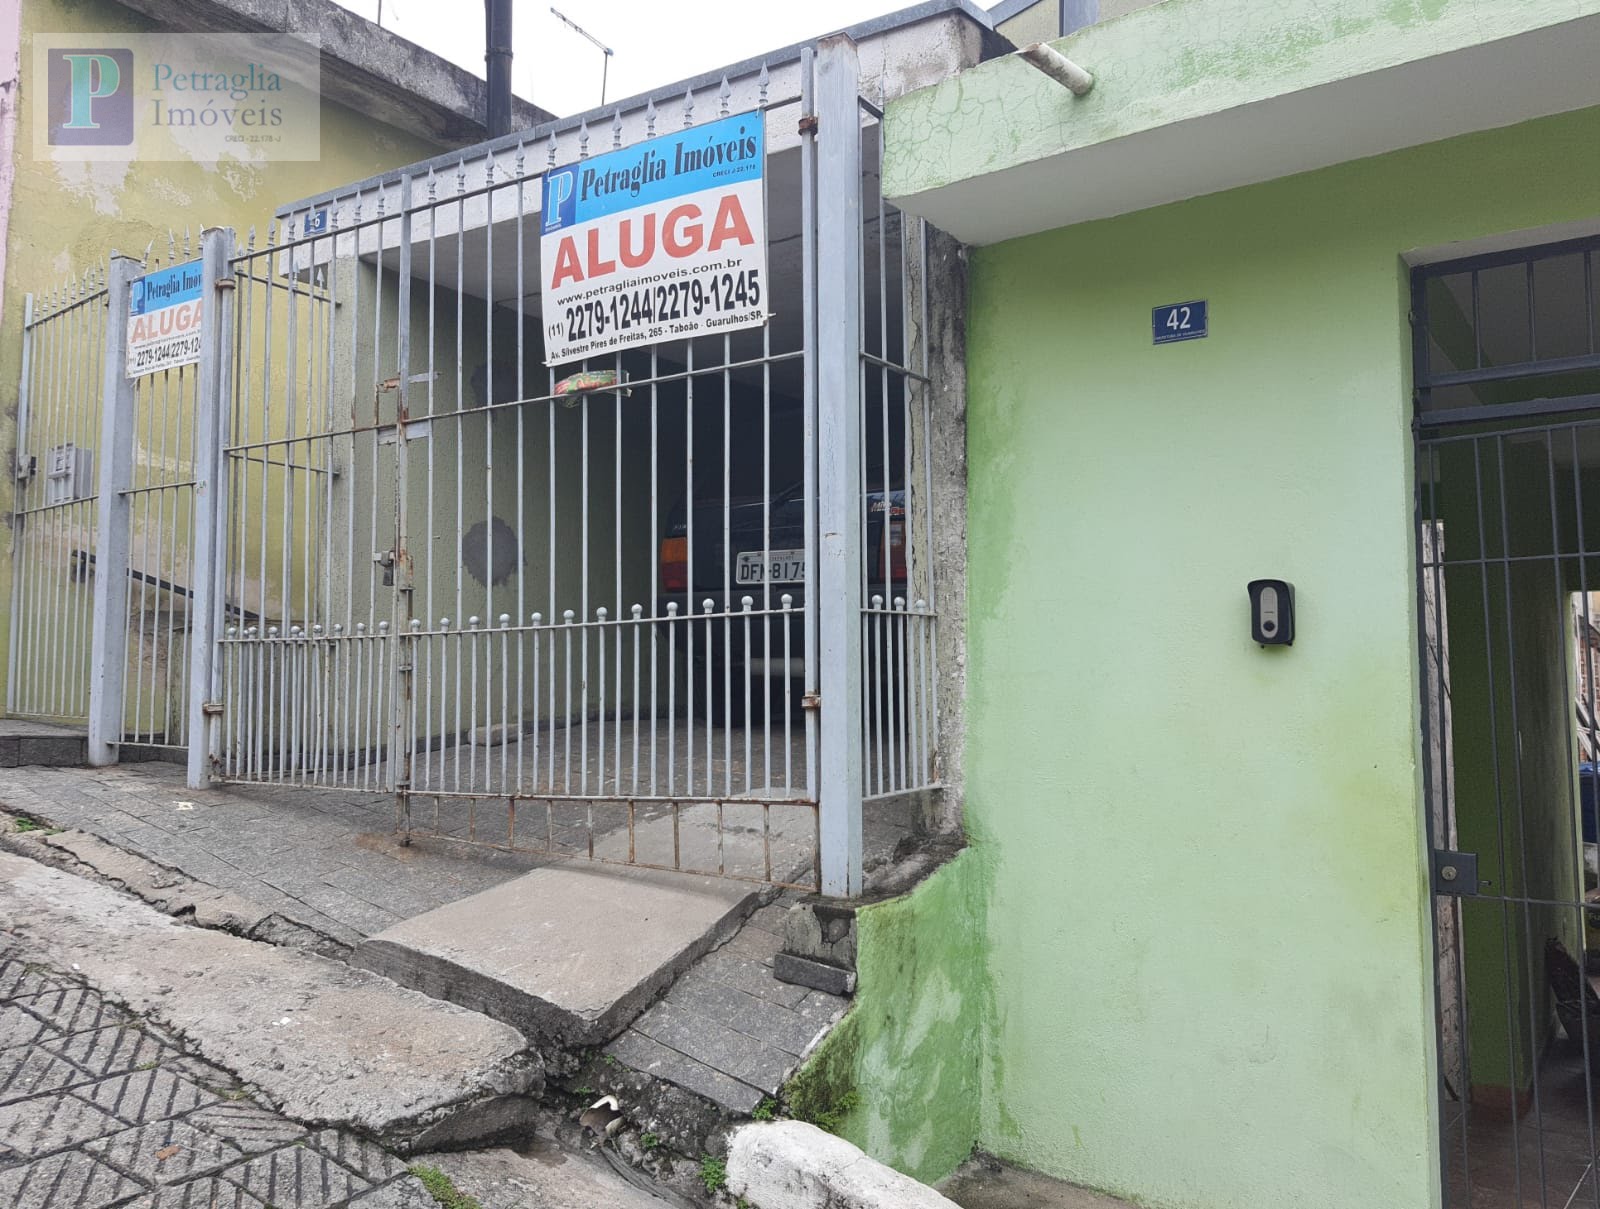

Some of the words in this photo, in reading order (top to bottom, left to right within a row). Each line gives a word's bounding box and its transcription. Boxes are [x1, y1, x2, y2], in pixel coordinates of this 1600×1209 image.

[581, 150, 667, 201] Petraglia
[674, 126, 757, 176] Imóveis
[545, 171, 573, 227] P
[551, 194, 756, 290] ALUGA
[147, 273, 180, 302] Petraglia
[556, 258, 743, 306] www.petragliaimoveis.com.br
[131, 299, 202, 343] ALUGA
[548, 322, 564, 340] (11)
[561, 342, 590, 358] Silvestre
[590, 339, 607, 350] Pires
[609, 337, 618, 345] de
[619, 331, 647, 344] Freitas,
[648, 326, 663, 338] 265
[669, 321, 699, 334] Taboão
[1166, 306, 1191, 330] 42
